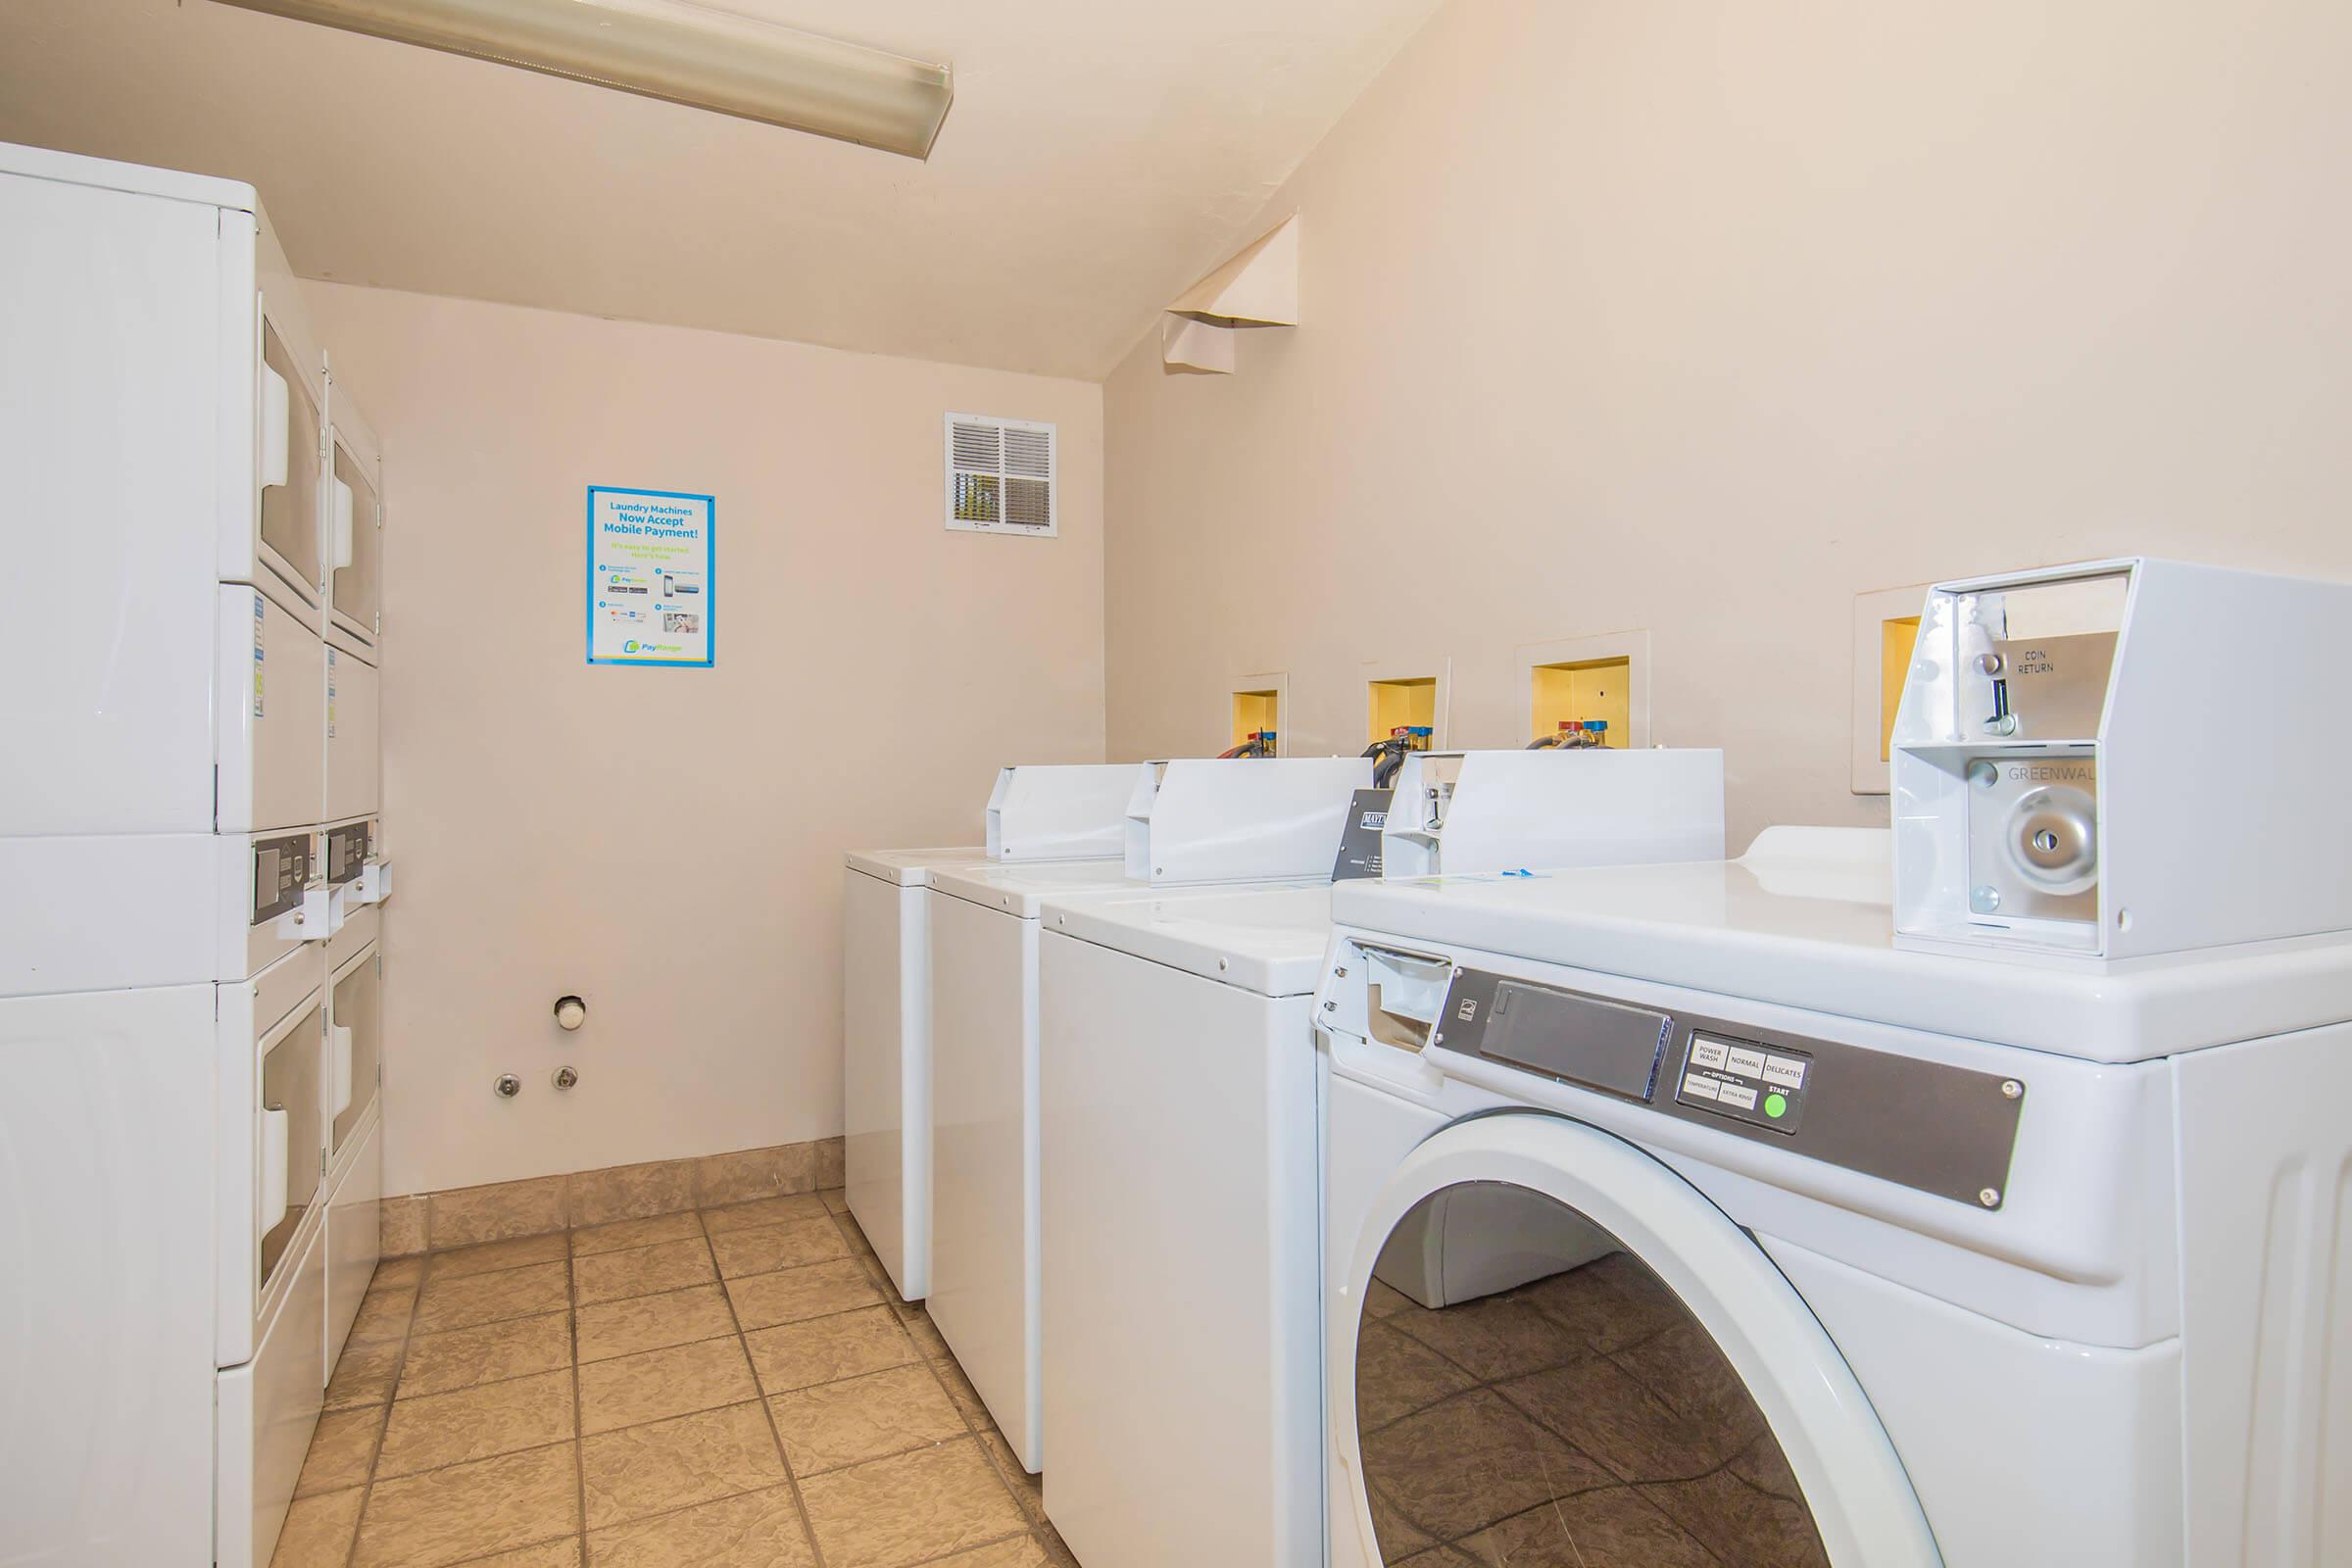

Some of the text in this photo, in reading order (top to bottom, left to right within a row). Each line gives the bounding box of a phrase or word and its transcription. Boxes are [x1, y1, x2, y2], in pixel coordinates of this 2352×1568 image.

[611, 502, 693, 516] Laundry Machines
[619, 513, 684, 527] Now Accept
[604, 523, 698, 539] Mobile Payment!
[2025, 651, 2046, 661] COIN
[2019, 663, 2054, 674] RETURN
[1699, 1046, 1722, 1056] POWER
[1699, 1053, 1719, 1062] WASH
[1731, 1056, 1760, 1069] NORMAL
[1766, 1064, 1802, 1078] DELICATES
[1711, 1072, 1735, 1083] OPTIONS
[1722, 1089, 1753, 1102] EXTRA RINSE
[1769, 1085, 1790, 1096] START
